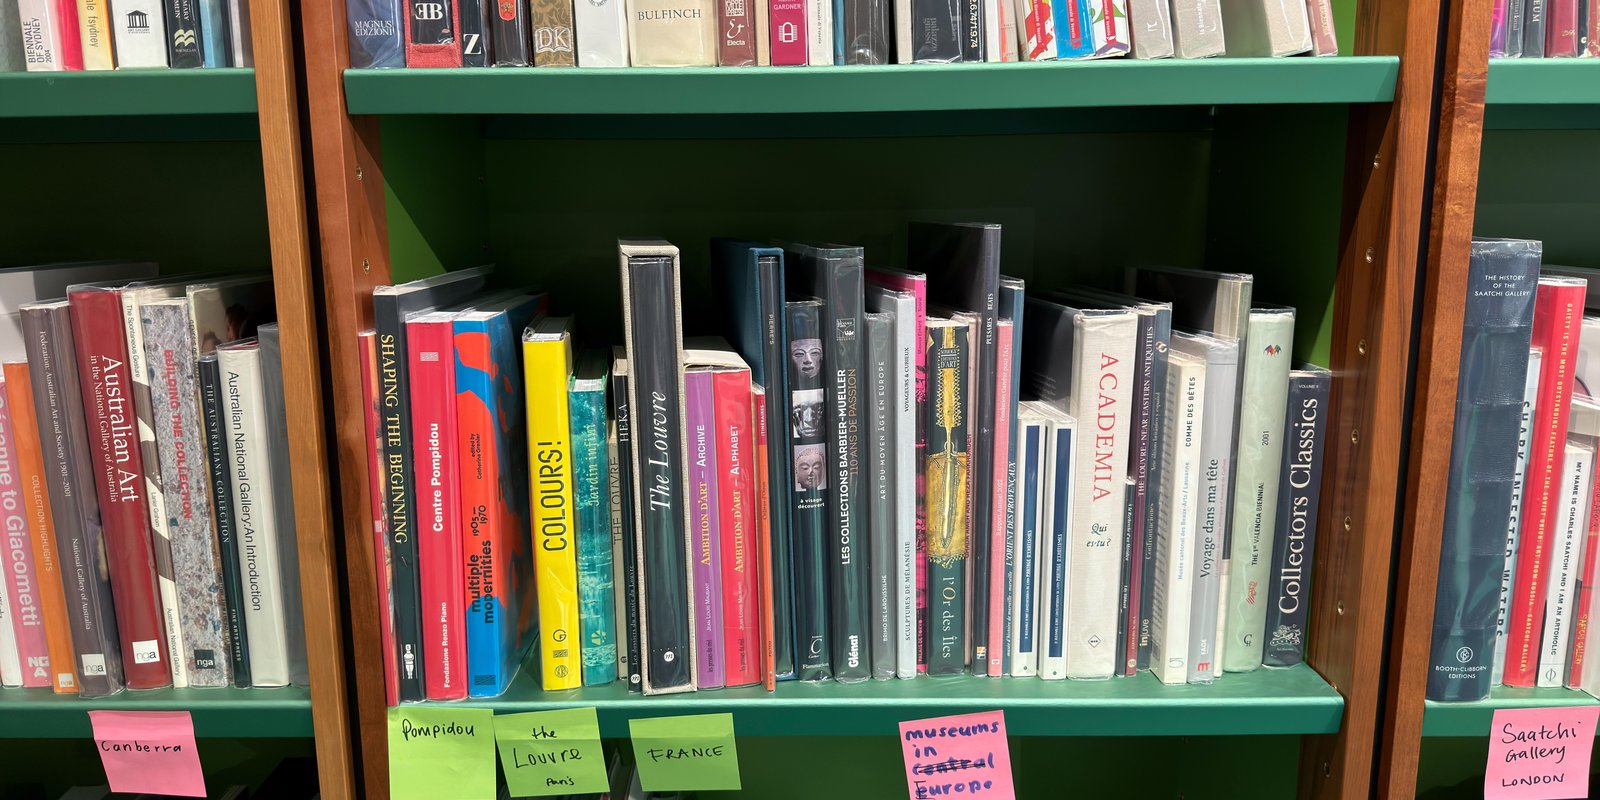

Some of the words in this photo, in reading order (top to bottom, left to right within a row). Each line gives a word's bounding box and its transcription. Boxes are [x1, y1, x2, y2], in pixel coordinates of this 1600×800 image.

[354, 20, 392, 28] MAGNUS
[638, 9, 701, 20] BULFINCH
[23, 21, 36, 63] BIENNALE
[32, 17, 43, 50] SYDNEY
[355, 28, 392, 36] EDIZIONI
[726, 39, 746, 47] Electa
[36, 53, 45, 63] OF
[986, 293, 994, 310] BEATS
[1564, 303, 1573, 329] GAIETY
[985, 317, 993, 345] PULSARES
[39, 331, 51, 370] Federation:
[90, 355, 99, 364] in
[127, 317, 137, 354] Spontaneous
[132, 355, 141, 378] Gesture
[1144, 326, 1153, 378] ANTIQUITIES
[1560, 343, 1568, 356] THE
[92, 366, 102, 380] the
[164, 349, 178, 409] BUILDING
[380, 334, 399, 408] SHAPING
[1558, 358, 1566, 378] MOST
[45, 371, 57, 407] Australian
[94, 382, 107, 419] National
[206, 384, 215, 404] THE
[227, 371, 242, 430] Australian
[847, 368, 857, 416] PASSION
[1142, 380, 1150, 416] EASTERN
[1186, 377, 1195, 401] BÊTES
[51, 408, 60, 419] Art
[102, 355, 133, 464] Australian
[837, 369, 848, 467] BARBIER-MUELLER
[1551, 381, 1563, 429] OUTSTANDING
[53, 420, 63, 433] and
[98, 421, 112, 452] Gallery
[171, 413, 182, 437] THE
[386, 413, 401, 447] THE
[618, 404, 629, 442] HEKA
[648, 391, 670, 468] Louvre
[848, 419, 857, 433] DE
[1093, 352, 1119, 503] ACADEMIA
[1185, 420, 1193, 447] COMME
[54, 435, 65, 460] Society
[208, 408, 222, 476] AUSTRALIANA
[696, 425, 706, 467] ARCHIVE
[729, 425, 740, 475] ALPHABET
[848, 435, 857, 457] ANS
[1261, 430, 1270, 446] 2001
[1289, 398, 1318, 488] Classics
[1546, 432, 1556, 461] FEATURE
[105, 454, 114, 462] of
[233, 433, 250, 481] National
[429, 423, 442, 486] Pompidou
[849, 459, 858, 476] 110
[1138, 447, 1146, 479] LOUVRE
[1576, 461, 1582, 472] MY
[175, 442, 192, 519] COLLECTION
[1206, 459, 1219, 482] tête
[1546, 464, 1552, 473] OF
[106, 464, 118, 502] Australia
[117, 468, 139, 502] Art
[540, 440, 567, 551] COLOURS!
[650, 474, 671, 511] The
[1006, 461, 1017, 514] PROVENÇAUX
[1207, 485, 1216, 504] ma
[1543, 476, 1551, 489] THE
[1572, 475, 1580, 495] NAME
[150, 492, 158, 507] Lanier
[216, 480, 229, 543] COLLECTION
[389, 454, 408, 544] BEGINNING
[431, 490, 443, 532] Centre
[840, 470, 850, 544] COLLECTIONS
[1541, 492, 1550, 516] SOVIET
[32, 475, 45, 522] COLLECTION
[40, 525, 52, 572] HIGHLIGHTS
[152, 508, 160, 527] Graham
[478, 505, 487, 524] 1970
[1006, 514, 1015, 530] DES
[1202, 507, 1215, 534] dans
[1566, 507, 1576, 539] CHARLES
[700, 514, 711, 566] AMBITION
[1091, 523, 1108, 535] Qui
[1145, 503, 1154, 560] Confrontaciones
[1536, 519, 1547, 542] UNION:
[72, 538, 82, 567] National
[733, 522, 744, 573] AMBITION
[842, 546, 850, 565] LES
[1199, 537, 1215, 578] Voyage
[1278, 496, 1308, 614] Collectors
[1562, 541, 1572, 570] SAATCHI
[902, 541, 911, 583] MÉLANÉSIE
[1532, 561, 1540, 579] FROM
[75, 568, 85, 592] Gallery
[245, 545, 262, 611] Introduction
[467, 554, 482, 613] multiple
[904, 584, 910, 594] DE
[80, 593, 89, 601] of
[1529, 581, 1538, 606] RUSSIA
[1558, 593, 1564, 604] AM
[81, 602, 92, 630] Australia
[166, 607, 174, 634] Australian
[440, 602, 448, 625] Piano
[942, 611, 954, 632] des
[1556, 606, 1562, 616] AN
[441, 627, 449, 646] Renzo
[1140, 618, 1150, 646] injuve
[1523, 614, 1533, 642] SAATCHI
[1550, 618, 1561, 656] ARTOHOLIC
[169, 635, 178, 656] National
[848, 635, 859, 668] Glénat
[1519, 644, 1529, 672] GALLERY
[172, 657, 181, 676] Gallery
[442, 647, 450, 688] Fondazione
[402, 718, 475, 742] Pompidou
[532, 727, 558, 740] the
[905, 721, 999, 741] museums
[1501, 721, 1581, 744] Saatchi
[101, 740, 182, 752] Canberra
[513, 748, 582, 769] Louvre
[647, 745, 724, 762] FRANCE
[912, 744, 938, 758] in
[1505, 746, 1566, 764] Gallery
[1501, 773, 1565, 787] LONDON
